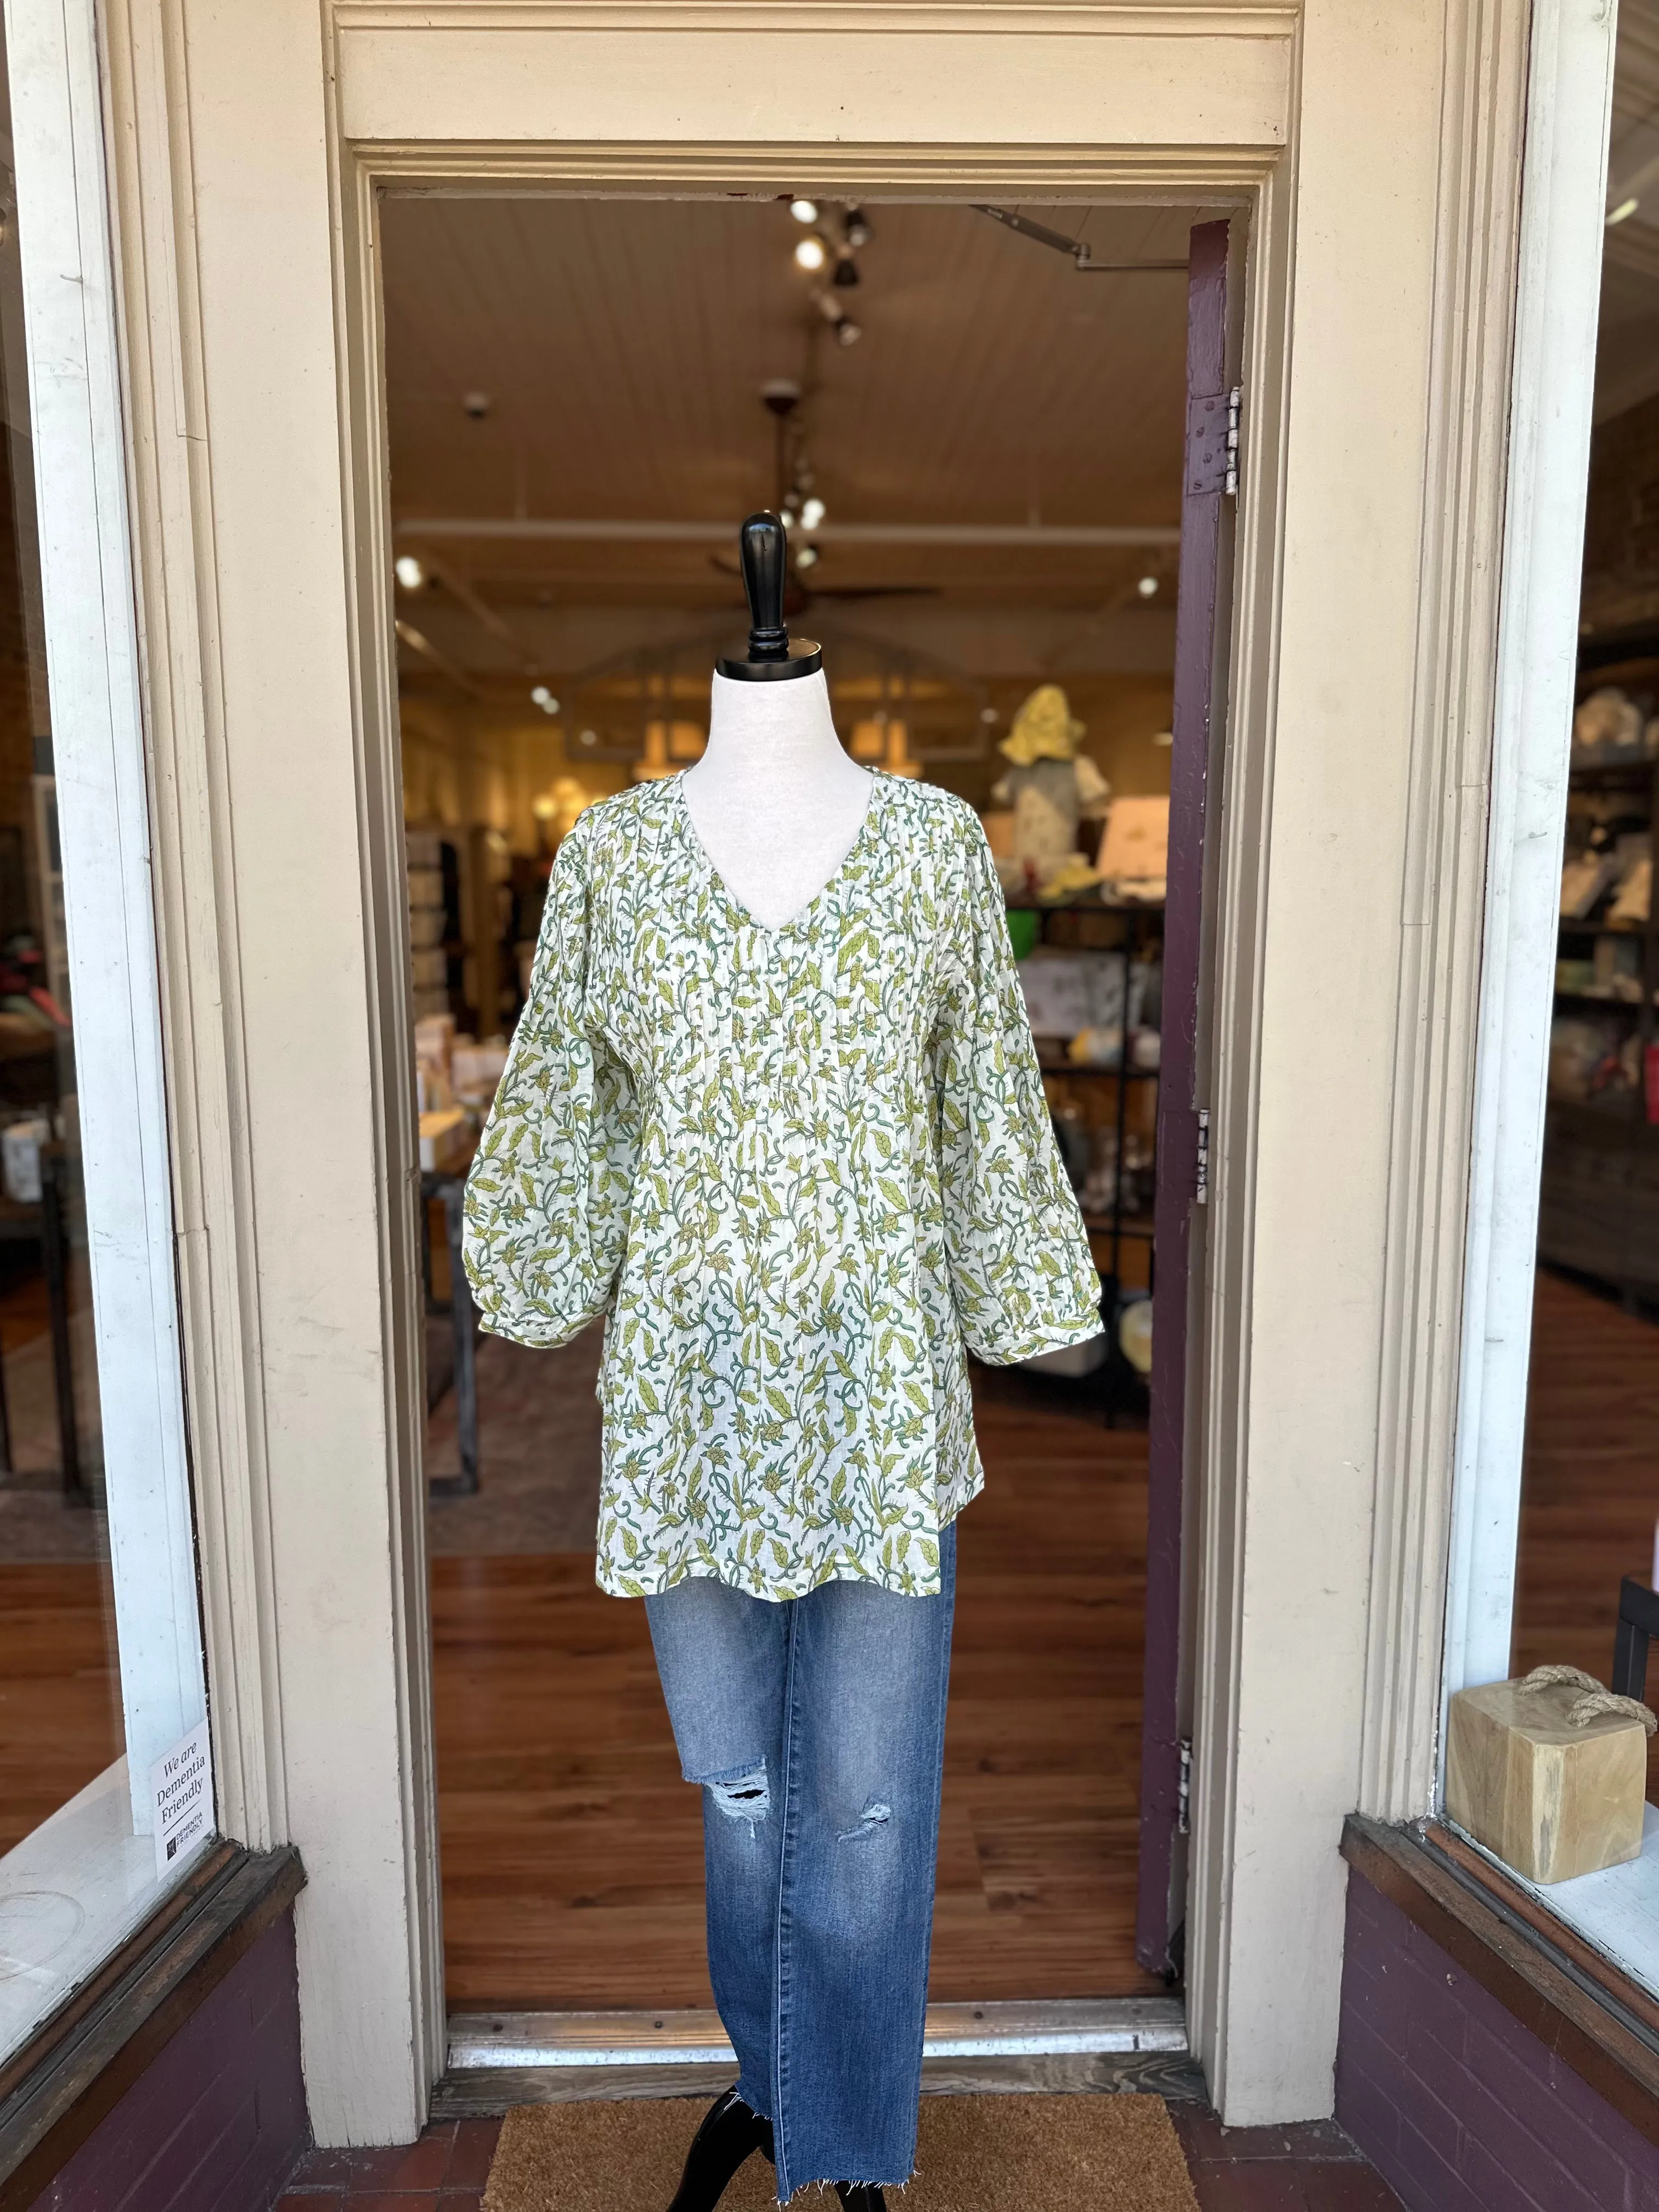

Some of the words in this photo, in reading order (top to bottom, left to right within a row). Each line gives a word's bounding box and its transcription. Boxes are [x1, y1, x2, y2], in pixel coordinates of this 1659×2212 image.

[164, 1757, 179, 1778] We
[181, 1742, 197, 1763] are
[157, 1756, 205, 1807] Dementia
[162, 1778, 203, 1824] Friendly
[176, 1812, 202, 1841] DEMENTIA
[177, 1818, 203, 1848] FRIENDLY
